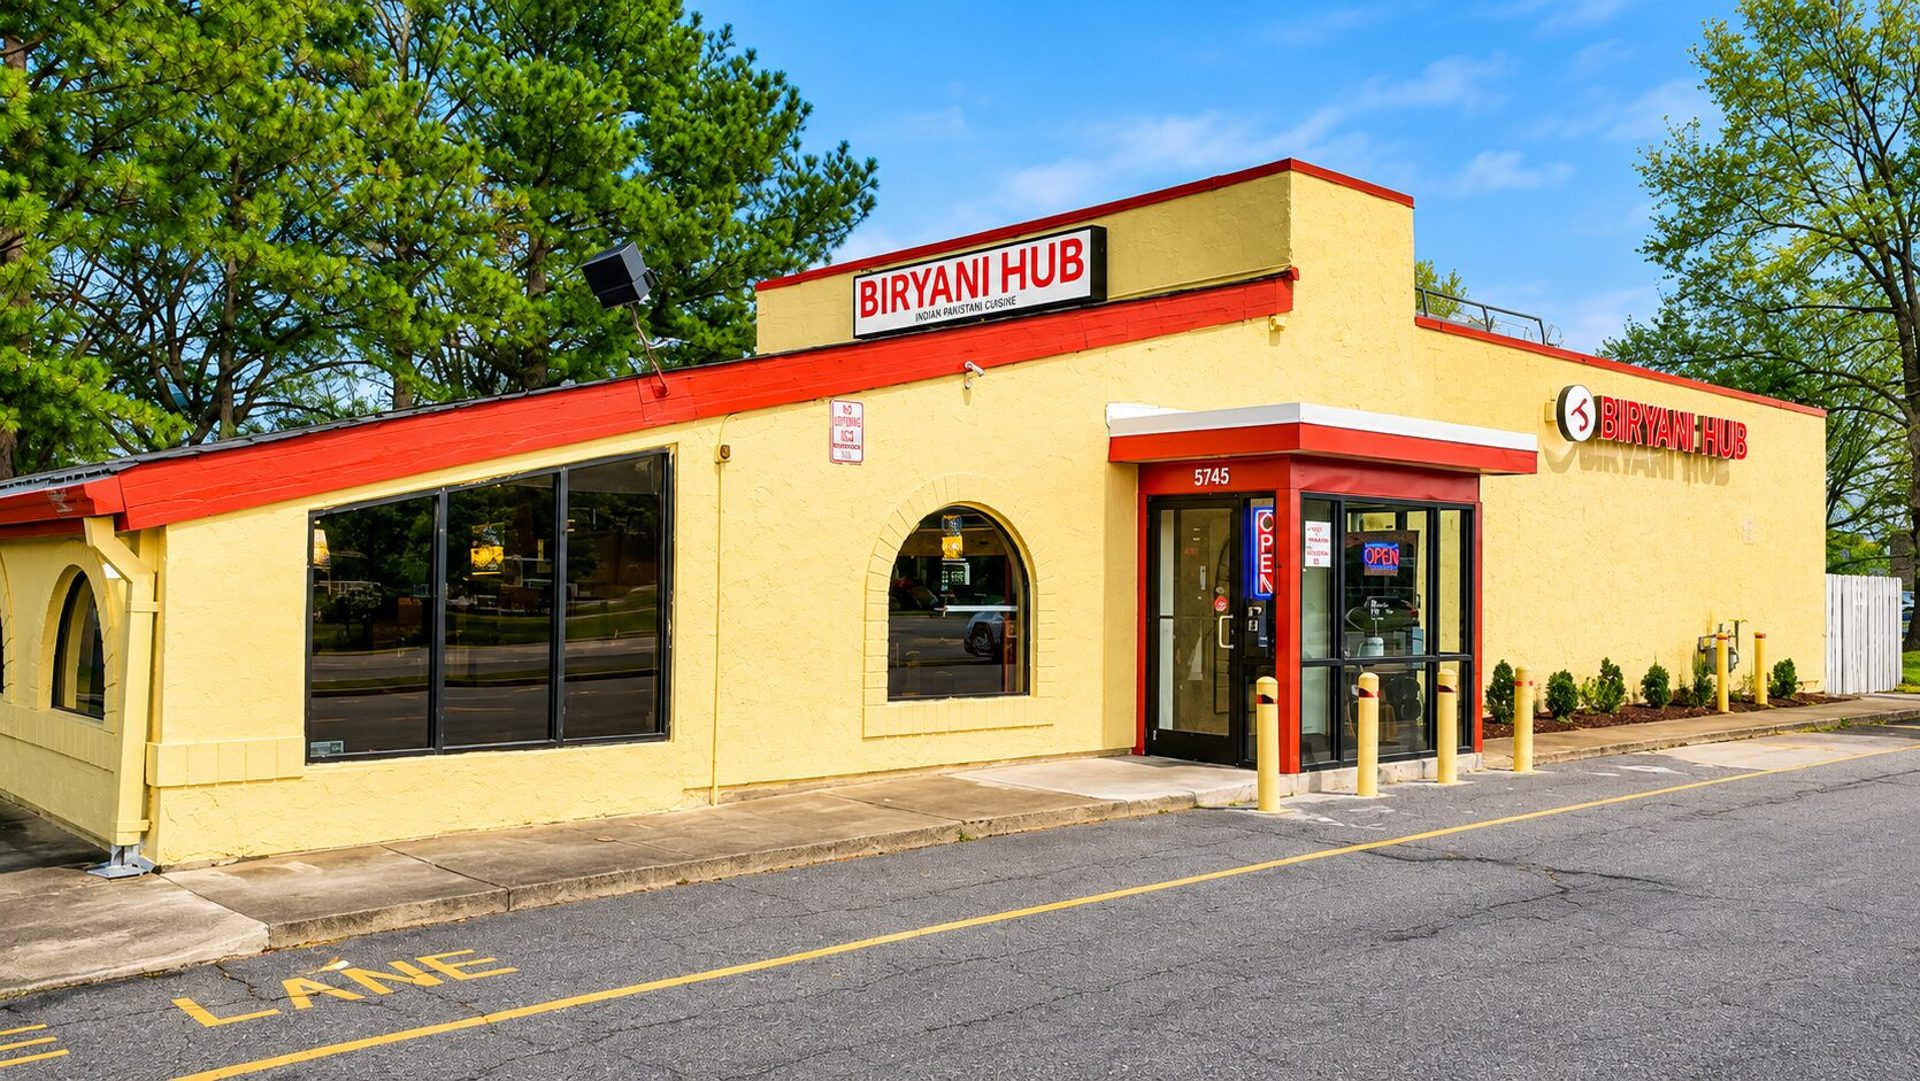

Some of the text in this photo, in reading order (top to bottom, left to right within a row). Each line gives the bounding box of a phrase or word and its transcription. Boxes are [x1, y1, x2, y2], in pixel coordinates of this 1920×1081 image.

[860, 238, 1085, 318] BIRYANI HUB
[915, 295, 1017, 322] INDIAN PAKISTANI CUISINE
[1601, 396, 1748, 460] BIRYANI HUB
[1194, 467, 1229, 486] 5745
[1259, 513, 1274, 594] OPEN
[1364, 546, 1399, 566] OPEN
[171, 949, 518, 1027] LANE
